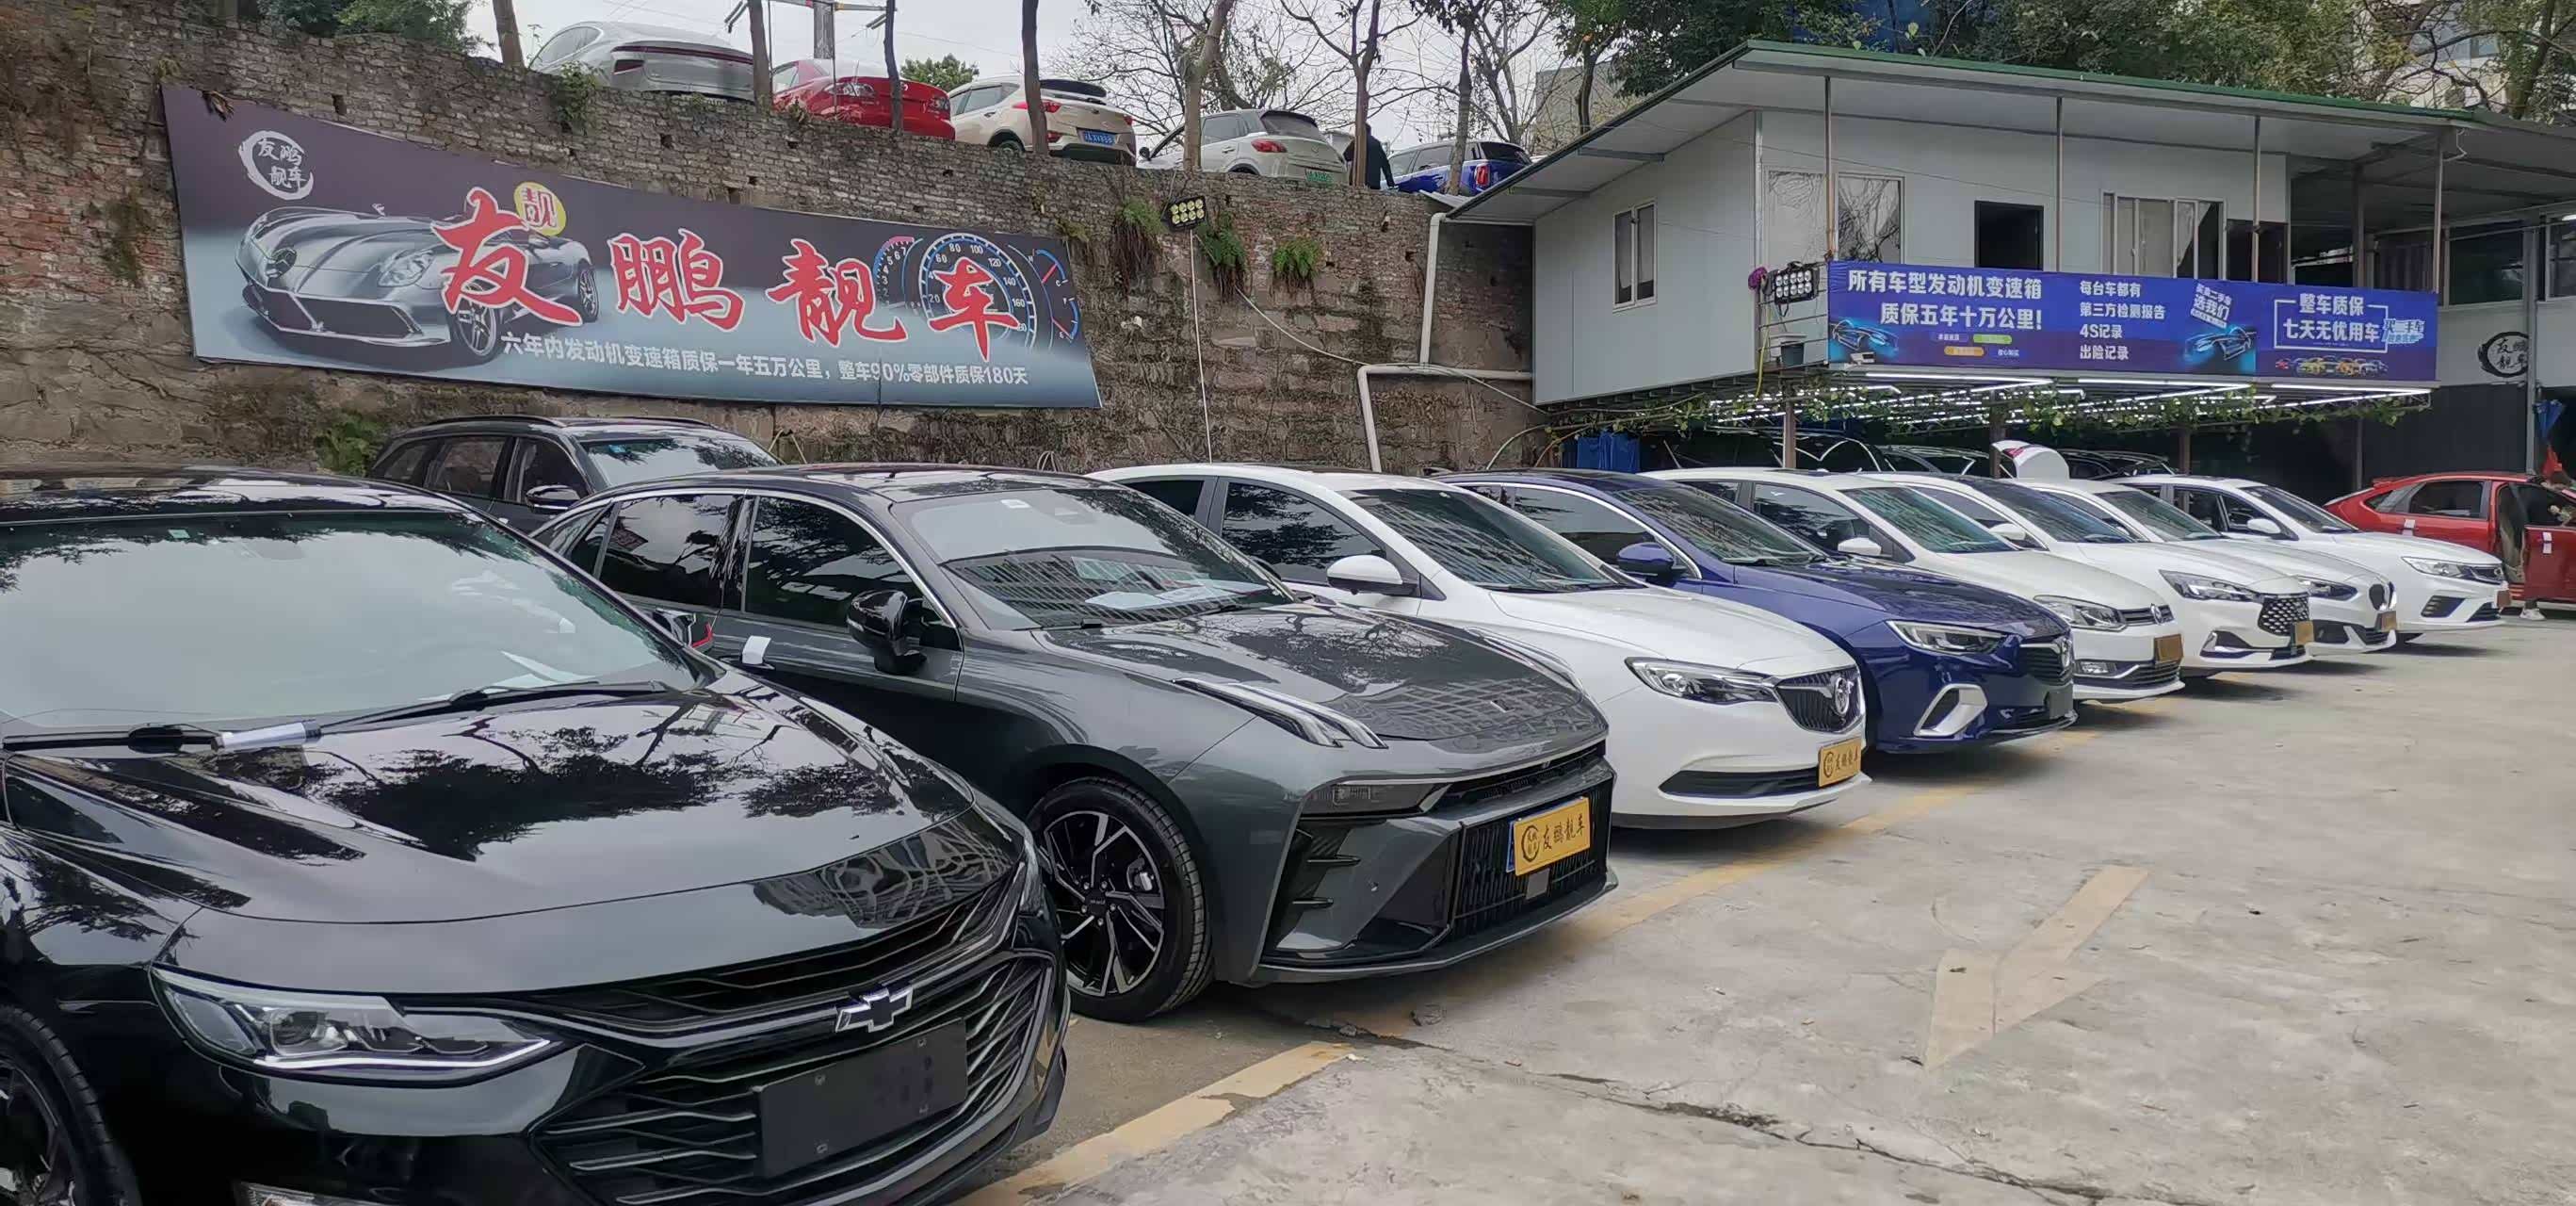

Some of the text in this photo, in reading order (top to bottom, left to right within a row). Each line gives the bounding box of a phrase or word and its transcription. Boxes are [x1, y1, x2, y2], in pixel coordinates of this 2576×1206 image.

[257, 138, 302, 166] 友鹏
[268, 165, 307, 189] 靓车
[1848, 269, 2042, 300] 所有车型发动机变速箱
[2080, 281, 2141, 298] 每台车都有
[2080, 302, 2165, 319] 第三方检测报告
[2194, 293, 2230, 321] 选我们
[2299, 293, 2365, 316] 整车质保
[2080, 323, 2122, 338] 4S记录
[2080, 344, 2129, 360] 出险记录
